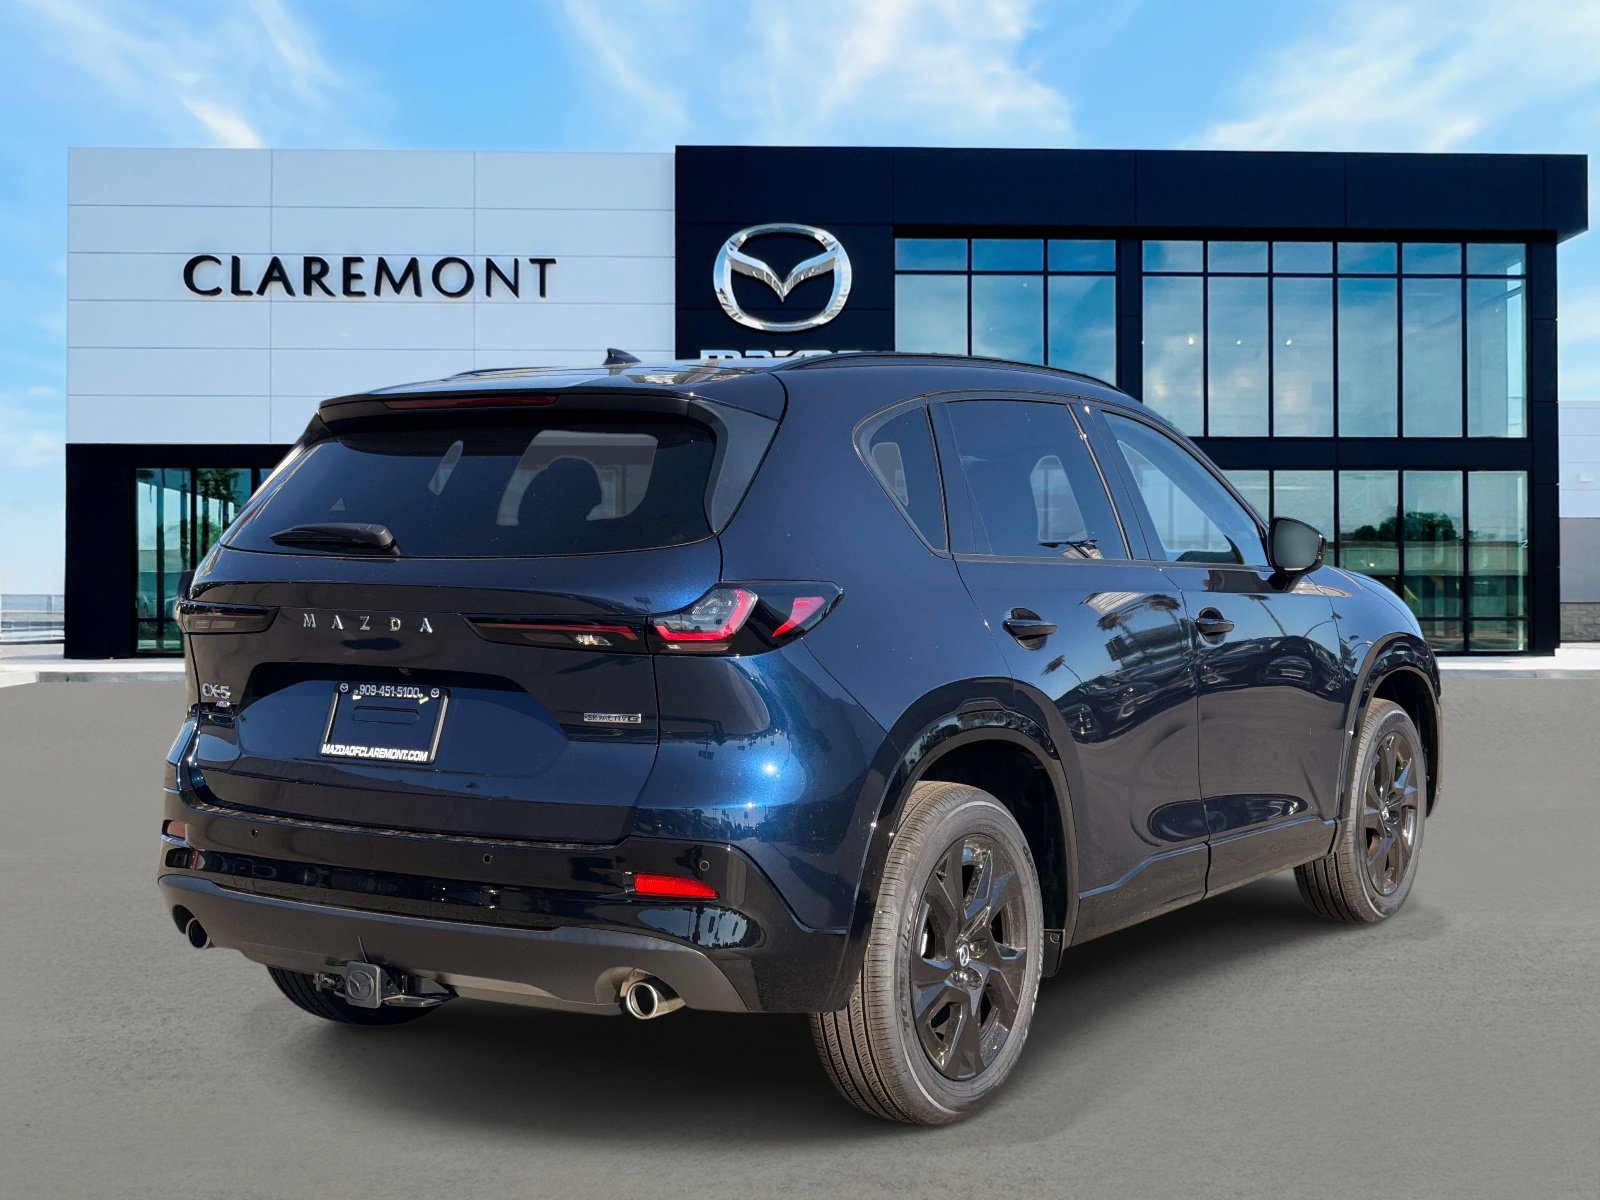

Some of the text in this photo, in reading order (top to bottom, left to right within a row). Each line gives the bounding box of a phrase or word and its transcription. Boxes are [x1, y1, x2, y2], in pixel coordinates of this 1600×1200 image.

[183, 254, 557, 298] CLAREMONT
[303, 613, 433, 633] MAZDA
[202, 683, 231, 699] CX-5
[359, 684, 420, 698] 909-451-5100
[321, 743, 429, 761] MAZDAOFCLAREMONT.COM
